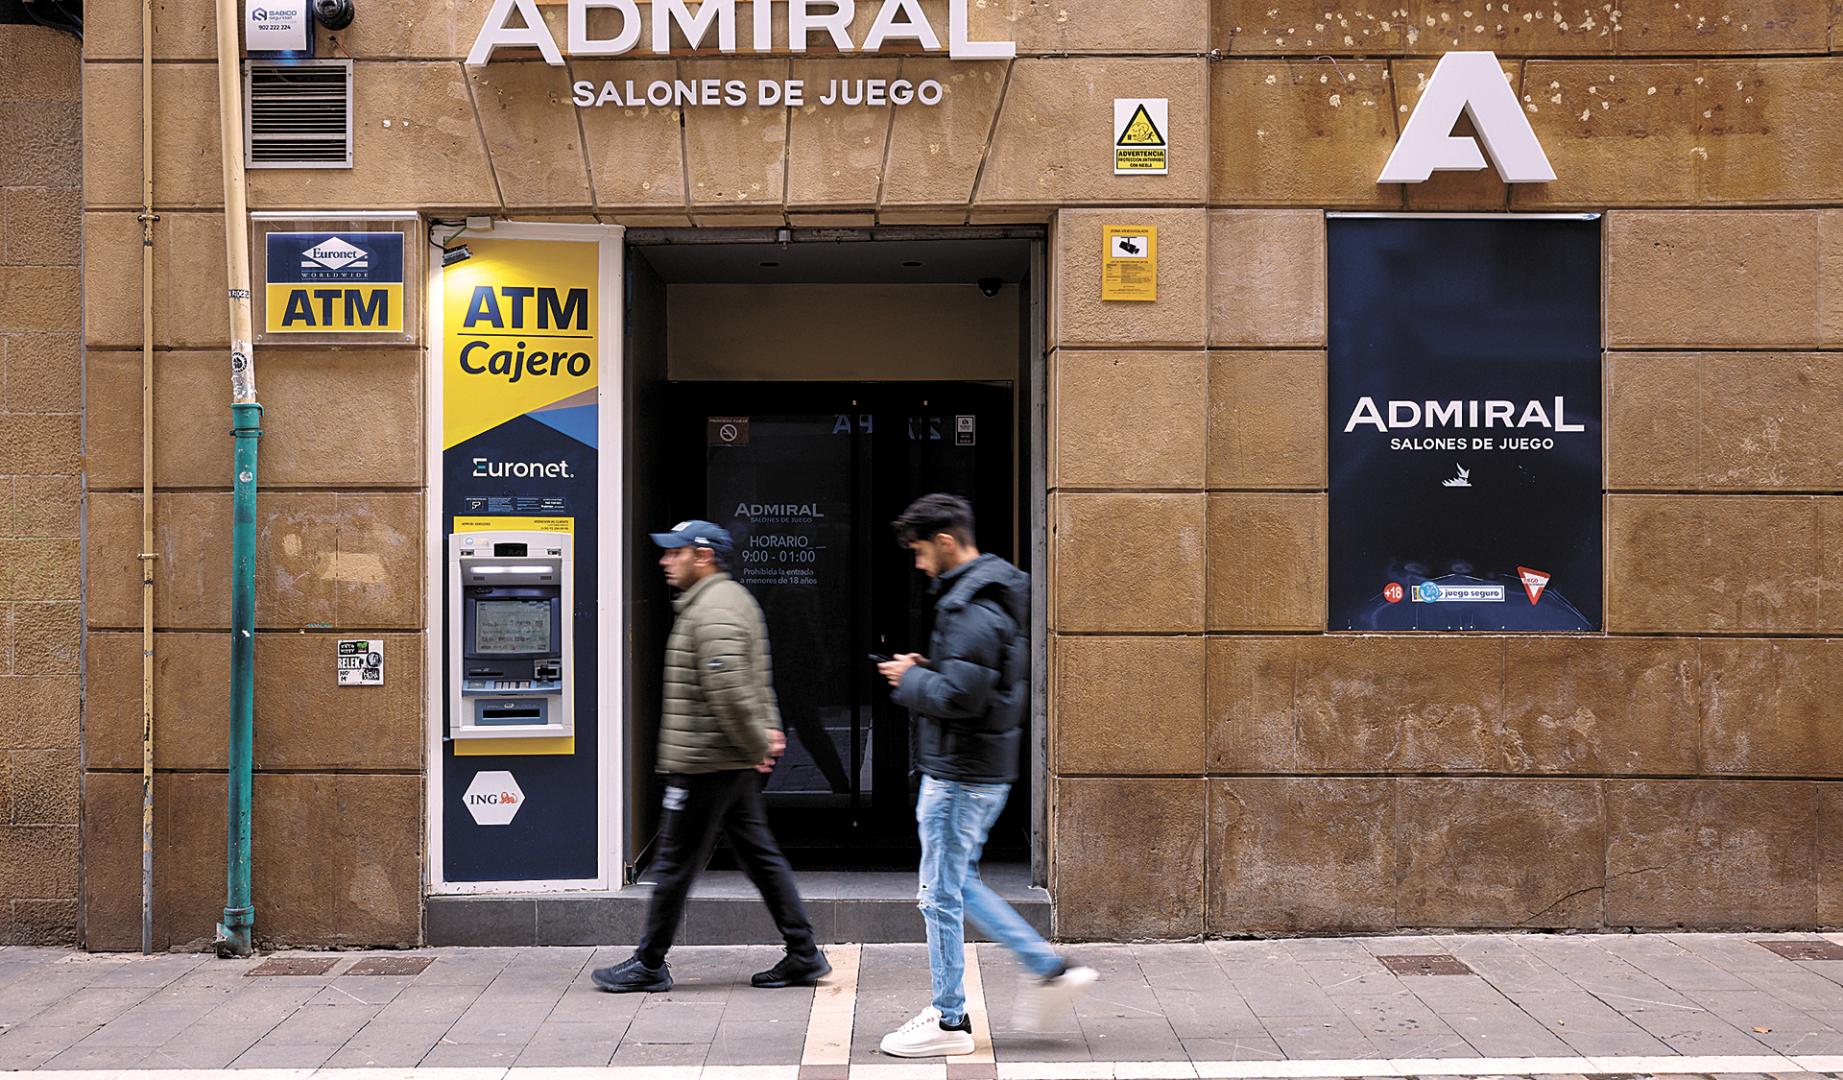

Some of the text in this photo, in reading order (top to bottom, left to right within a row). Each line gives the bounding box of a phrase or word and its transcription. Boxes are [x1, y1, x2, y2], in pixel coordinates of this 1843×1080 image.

[465, 0, 1016, 66] ADMIRAL
[572, 79, 944, 107] SALONES DE JUEGO
[1376, 51, 1558, 183] A
[312, 248, 357, 259] Euronet
[281, 289, 389, 326] ATM
[463, 286, 589, 330] ATM
[459, 340, 591, 383] Cajero
[1344, 396, 1585, 432] ADMIRAL
[1390, 438, 1554, 450] SALONES DE JUEGO
[734, 503, 825, 517] ADMIRAL
[749, 535, 809, 547] HORARIO
[742, 550, 768, 562] 9:00
[779, 550, 816, 562] 01:00
[743, 567, 814, 576] Prohibida la entrada
[779, 576, 788, 584] de
[790, 576, 799, 585] 18
[800, 576, 817, 585] años
[1384, 586, 1403, 598] +18
[1445, 588, 1500, 598] juego seguro
[470, 794, 497, 805] ING
